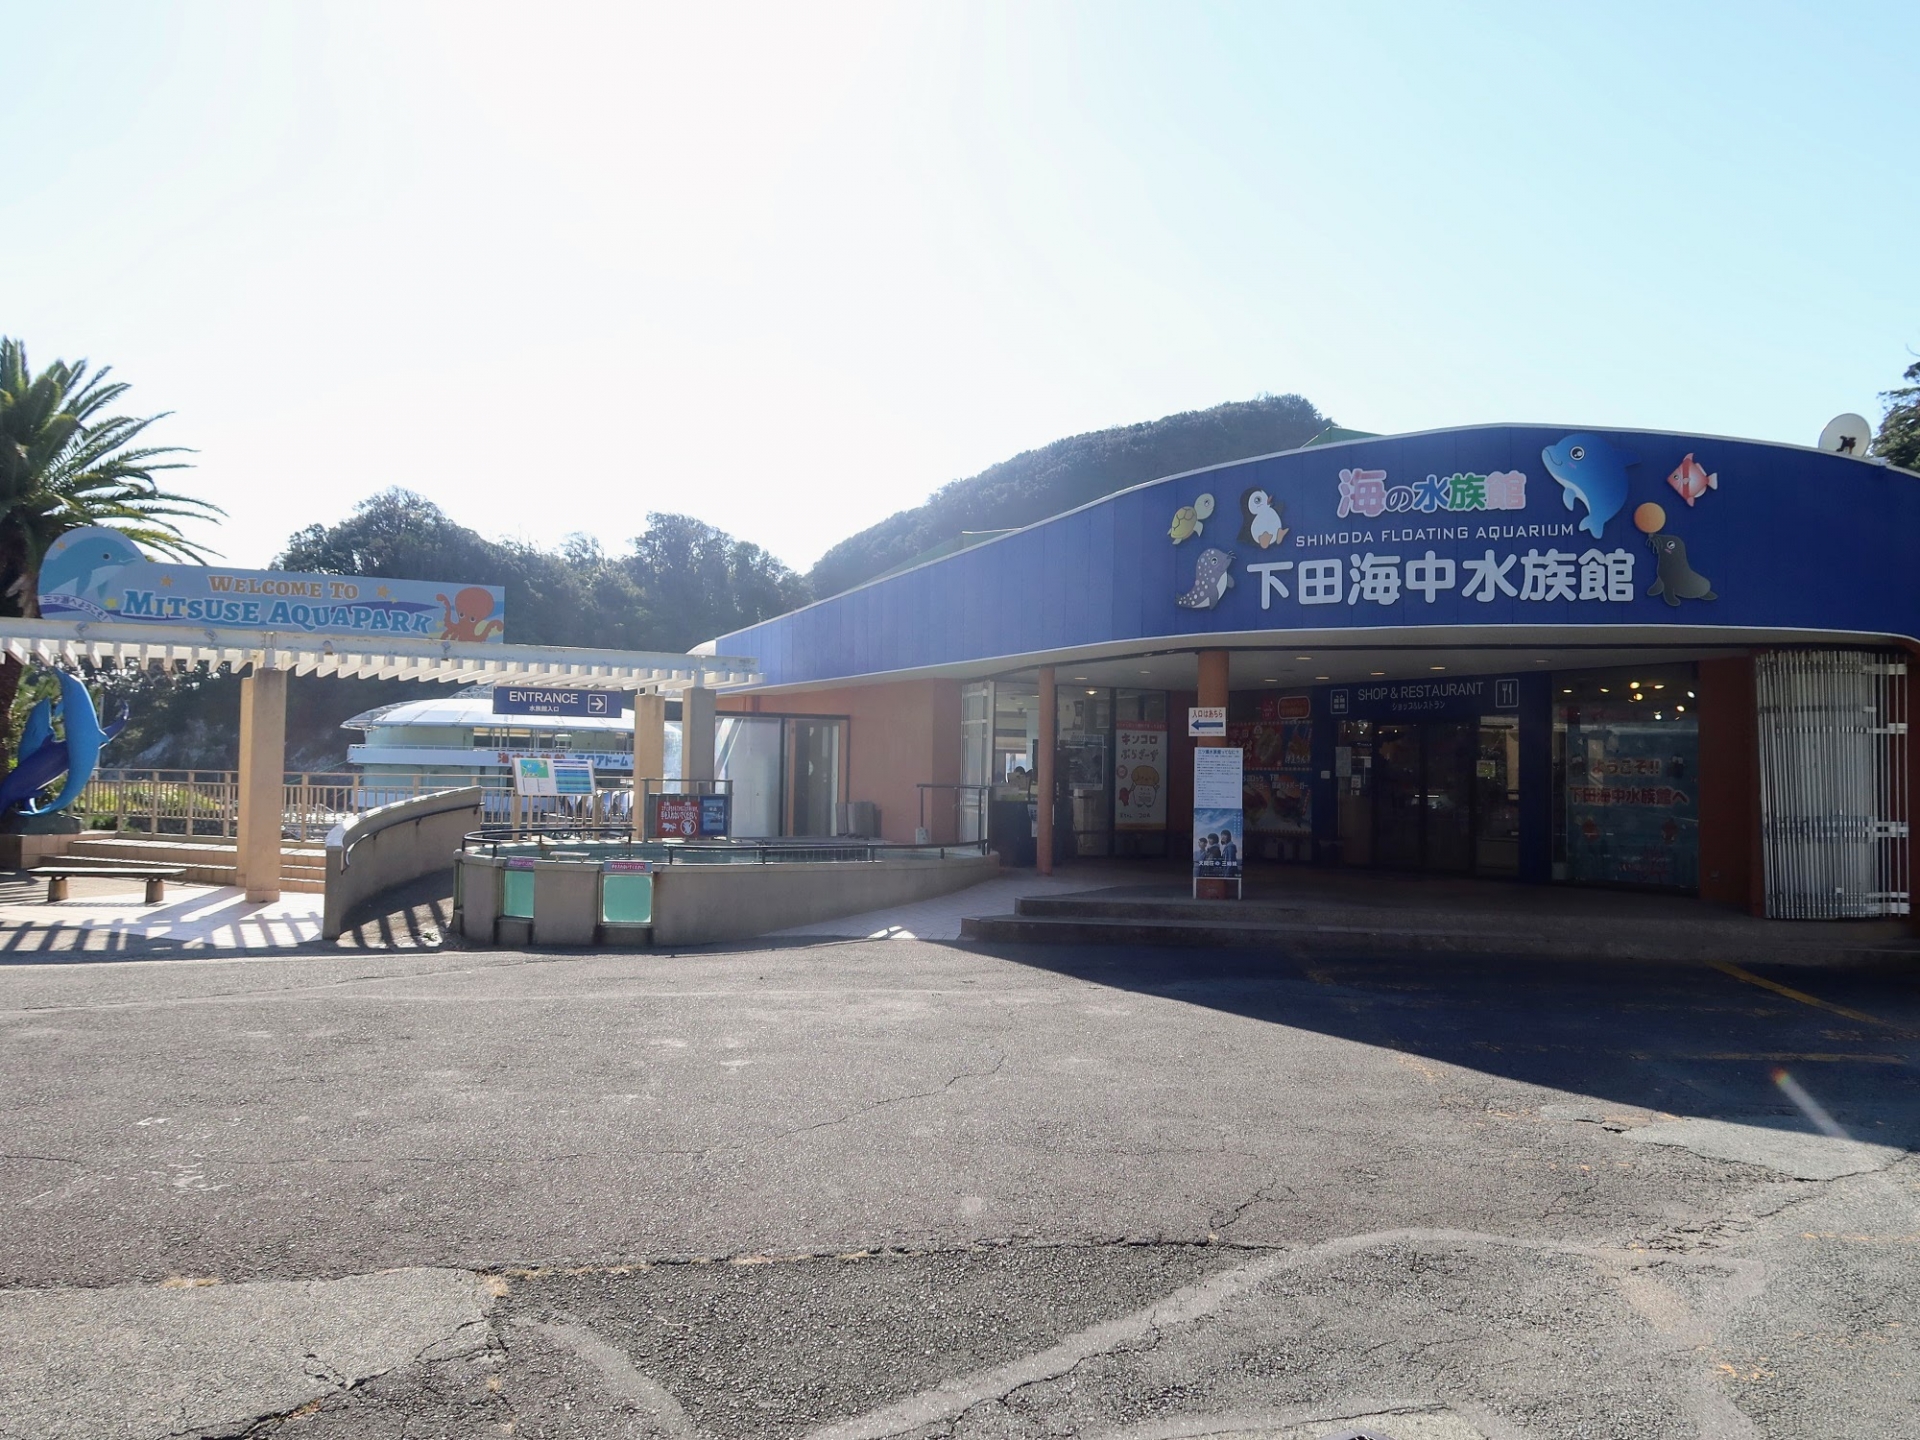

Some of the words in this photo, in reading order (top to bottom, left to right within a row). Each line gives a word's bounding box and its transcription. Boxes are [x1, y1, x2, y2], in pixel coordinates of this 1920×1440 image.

[1337, 468, 1527, 518] 海の水族館
[1295, 530, 1374, 548] SHIMODA
[1381, 526, 1469, 543] FLOATING
[1475, 522, 1575, 541] AQUARIUM
[207, 574, 322, 598] WELCOME
[329, 580, 359, 600] TO
[1246, 548, 1636, 610] 下田海中水族館
[121, 588, 259, 623] MITSUSE
[267, 600, 434, 634] AQUAPARK
[509, 690, 579, 704] ENTRANCE
[1357, 687, 1388, 701] SHOP
[1390, 686, 1399, 699] &
[1400, 681, 1485, 699] RESTAURANT
[1191, 709, 1223, 719] 入口はあちら
[1121, 732, 1158, 745] キンコロ
[1590, 758, 1660, 775] ようこそ!!
[1569, 786, 1689, 805] 下田海中水族館へ
